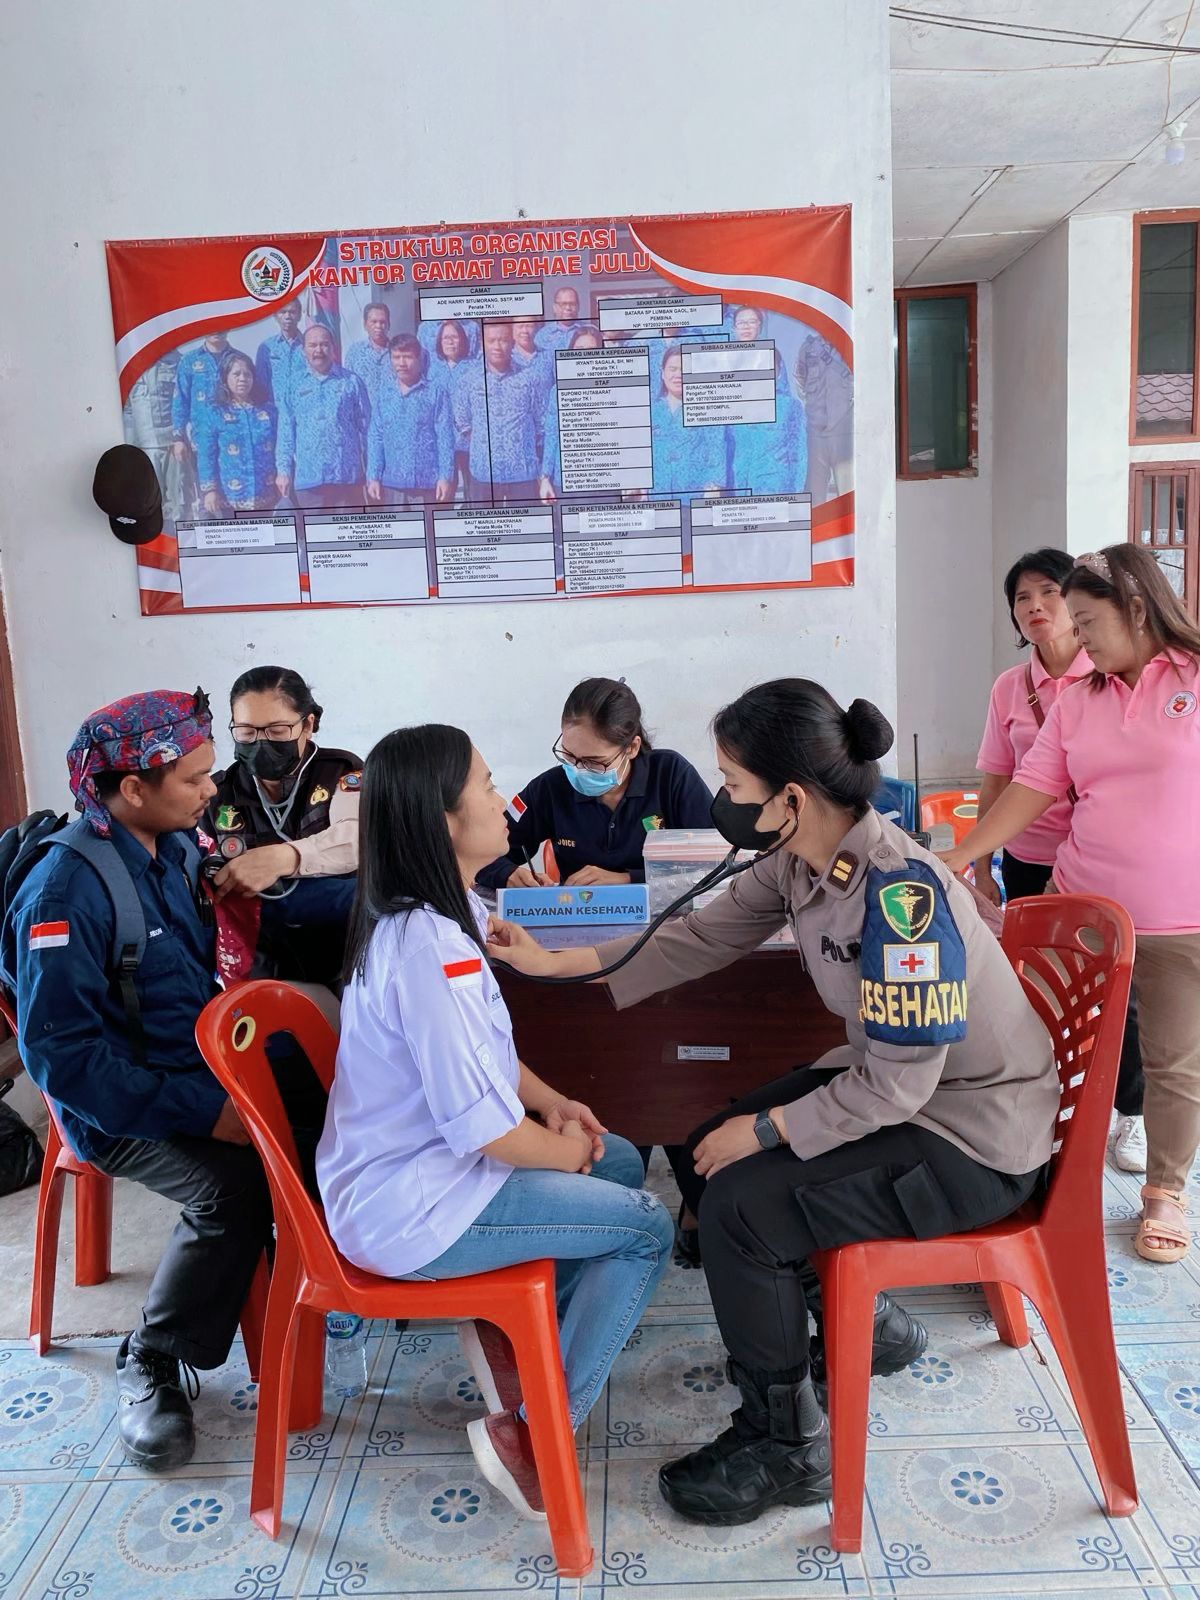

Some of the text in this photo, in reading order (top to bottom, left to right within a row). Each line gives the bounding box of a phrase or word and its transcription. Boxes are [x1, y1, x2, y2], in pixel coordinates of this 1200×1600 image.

[339, 228, 617, 262] STRUKTUR ORGANISASI
[309, 251, 651, 288] KANTOR CAMAT PAHAE JULU
[557, 838, 576, 848] JOICE
[506, 905, 644, 917] PELAYANAN KESEHATAN
[330, 1319, 353, 1329] AQUA
